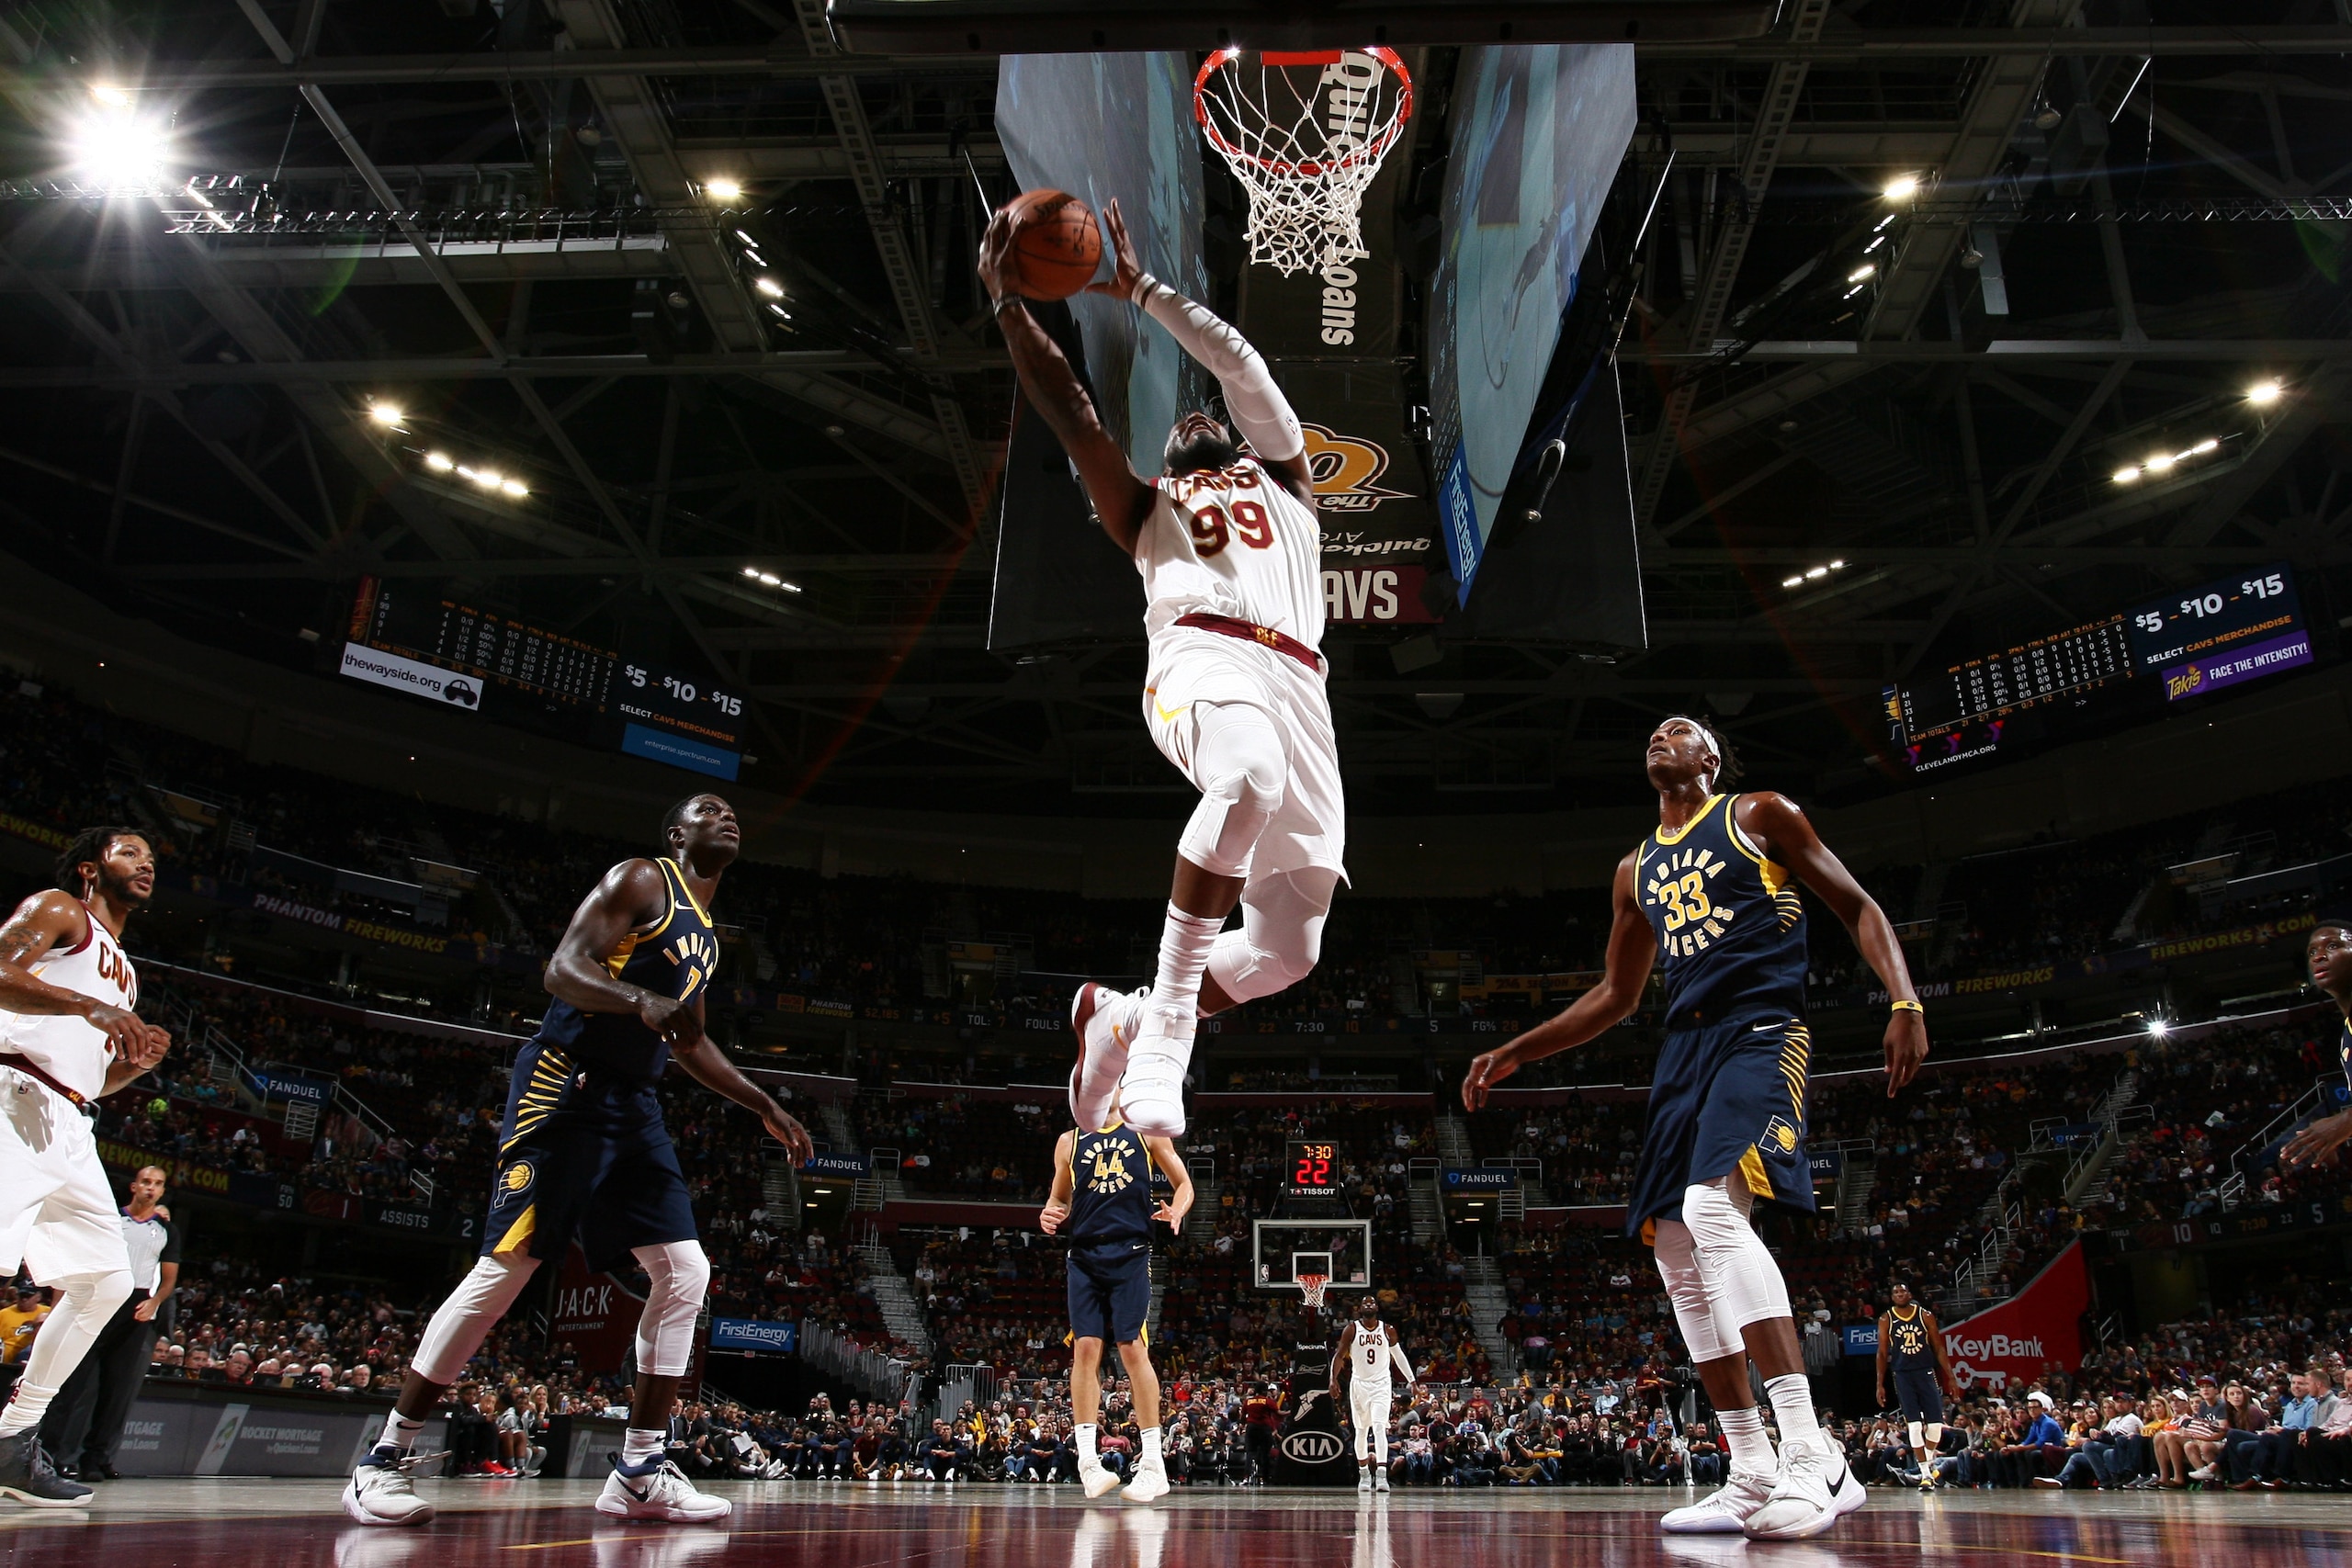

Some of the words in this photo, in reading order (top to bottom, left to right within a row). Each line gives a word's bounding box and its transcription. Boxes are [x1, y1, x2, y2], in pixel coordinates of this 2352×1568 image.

[1320, 244, 1370, 346] Loans
[1190, 501, 1274, 558] 99
[1319, 536, 1431, 556] Quicke
[2135, 611, 2164, 633] $5
[2180, 592, 2223, 618] $10
[2241, 572, 2285, 600] $15
[2146, 646, 2184, 664] SELECT
[2186, 637, 2214, 652] CAVS
[2215, 615, 2293, 644] MERCHANDISE
[1902, 691, 1910, 699] 44
[1970, 669, 1981, 677] 0/1
[1989, 663, 2001, 671] 0%
[2012, 655, 2024, 664] 0/1
[2031, 649, 2045, 659] 0/0
[2098, 628, 2108, 637] -5
[1904, 699, 1912, 707] 21
[1970, 678, 1983, 687] 0/0
[1992, 671, 2003, 680] 0%
[2013, 663, 2027, 673] 0/0
[2034, 658, 2045, 667] 1/2
[2100, 638, 2109, 647] -5
[2209, 663, 2233, 681] FACE
[2233, 658, 2255, 672] THE
[2254, 642, 2309, 668] INTENSITY!
[345, 654, 441, 692] thewayside.org
[1904, 707, 1914, 716] 33
[1972, 685, 1984, 695] 0/2
[1993, 681, 2005, 689] 0%
[2015, 672, 2028, 682] 0/1
[2035, 666, 2049, 676] 0/0
[2102, 647, 2111, 655] -5
[1974, 694, 1986, 704] 2/4
[1993, 688, 2009, 698] 50%
[2018, 681, 2030, 690] 0/1
[2037, 674, 2051, 684] 0/0
[2104, 655, 2114, 664] -5
[2166, 666, 2201, 701] Takis
[625, 664, 648, 688] $5
[662, 675, 696, 703] $10
[711, 690, 742, 716] $15
[1975, 703, 1988, 712] 0/0
[1996, 697, 2008, 705] 0%
[2018, 689, 2031, 699] 0/0
[2039, 682, 2052, 693] 0/0
[2106, 664, 2115, 672] -5
[619, 703, 652, 718] SELECT
[653, 713, 676, 726] CAVS
[676, 718, 736, 743] MERCHANDISE
[1910, 731, 1927, 742] TEAM
[1928, 726, 1951, 738] TOTALS
[2020, 700, 2034, 710] 0/3
[2041, 694, 2053, 704] 1/2
[1645, 848, 1726, 906] INDIANA
[1657, 870, 1711, 931] 33
[253, 894, 342, 929] PHANTOM
[344, 919, 448, 953] FIREWORKS
[2151, 929, 2253, 960] FIREWORKS
[1954, 965, 2054, 994] FIREWORKS
[806, 1006, 854, 1019] FIREWORKS
[810, 998, 854, 1010] PHANTOM
[967, 1014, 991, 1027] TOL:
[1024, 1017, 1061, 1032] FOULS
[1206, 1021, 1222, 1034] 10
[1258, 1021, 1276, 1033] 22
[1295, 1021, 1325, 1033] 7:30
[1429, 1020, 1440, 1033] 5
[1472, 1021, 1497, 1032] FG%
[269, 1079, 322, 1100] FANDUEL
[1304, 1145, 1332, 1159] 7:30
[818, 1157, 864, 1171] FANDUEL
[1094, 1150, 1125, 1180] 44
[1296, 1159, 1329, 1185] 22
[193, 1168, 229, 1192] COM
[1461, 1174, 1508, 1183] FANDUEL
[278, 1193, 293, 1208] 50
[379, 1209, 430, 1229] ASSISTS
[460, 1218, 475, 1238] 2
[2242, 1216, 2268, 1231] 7:30
[2280, 1213, 2294, 1224] 22
[2311, 1203, 2324, 1224] 5
[2172, 1223, 2193, 1244] 10
[558, 1321, 605, 1332] ENTERTAINMENT
[718, 1321, 790, 1343] FirstEnergy
[1359, 1334, 1383, 1346] CAVS
[1903, 1331, 1917, 1348] 21
[1945, 1334, 2044, 1361] KeyBank
[1366, 1348, 1375, 1365] 9
[240, 1426, 277, 1440] ROCKET
[276, 1427, 323, 1442] MORTGAGE
[1293, 1438, 1333, 1456] KIA
